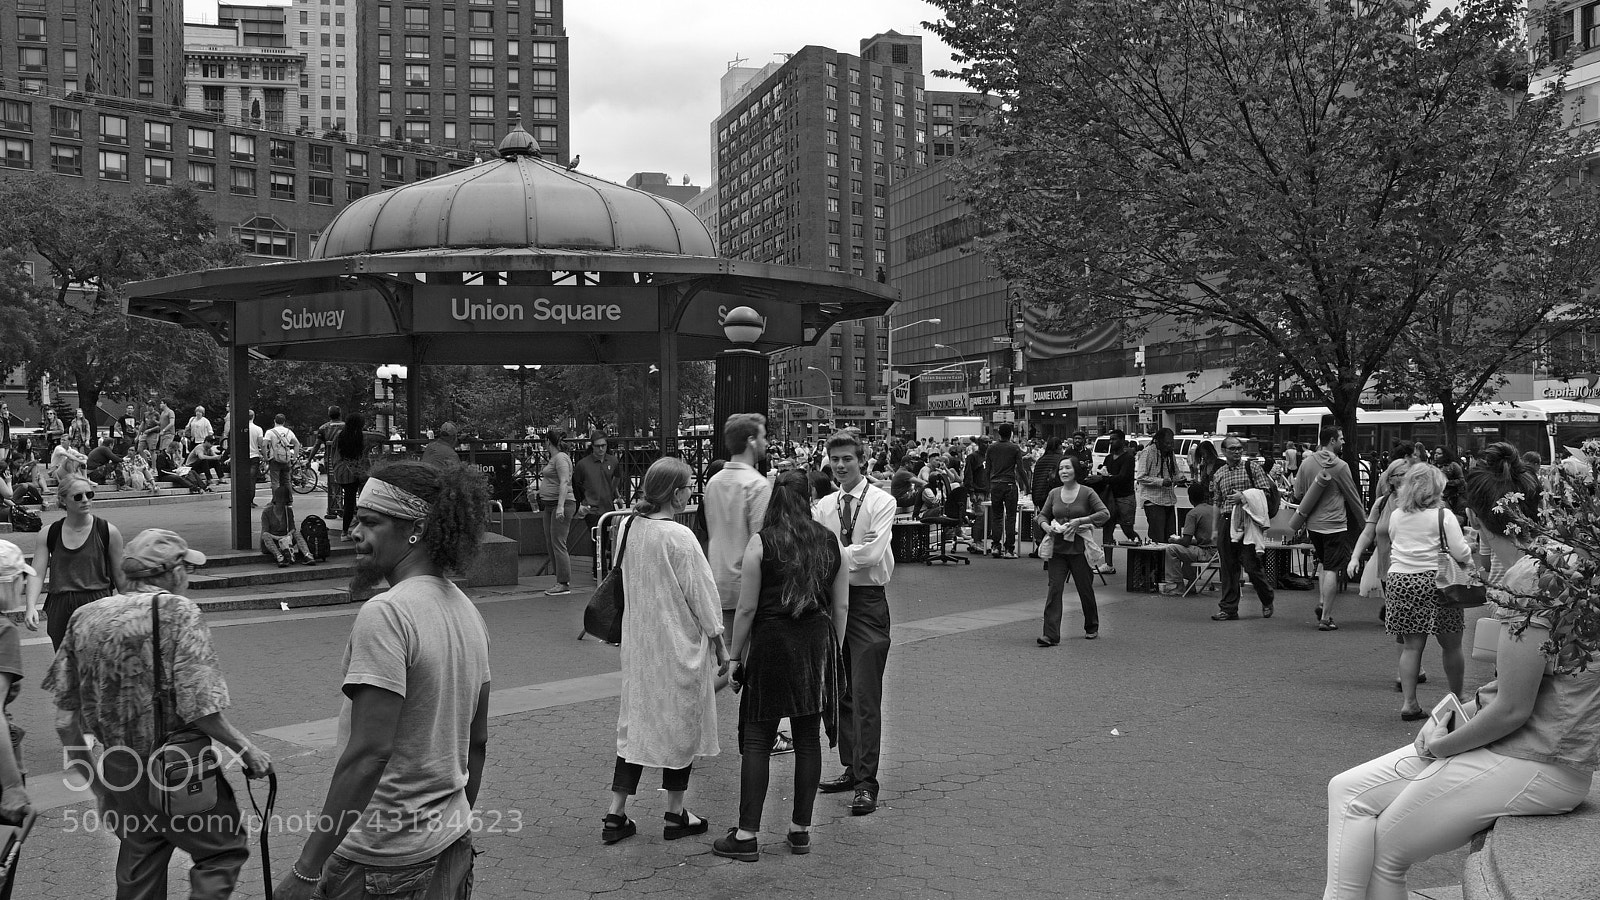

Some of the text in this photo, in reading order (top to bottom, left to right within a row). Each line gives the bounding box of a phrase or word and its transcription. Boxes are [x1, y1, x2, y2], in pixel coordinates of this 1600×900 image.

[280, 308, 345, 331] Subway
[450, 297, 622, 325] Union Square
[896, 388, 908, 399] BUY
